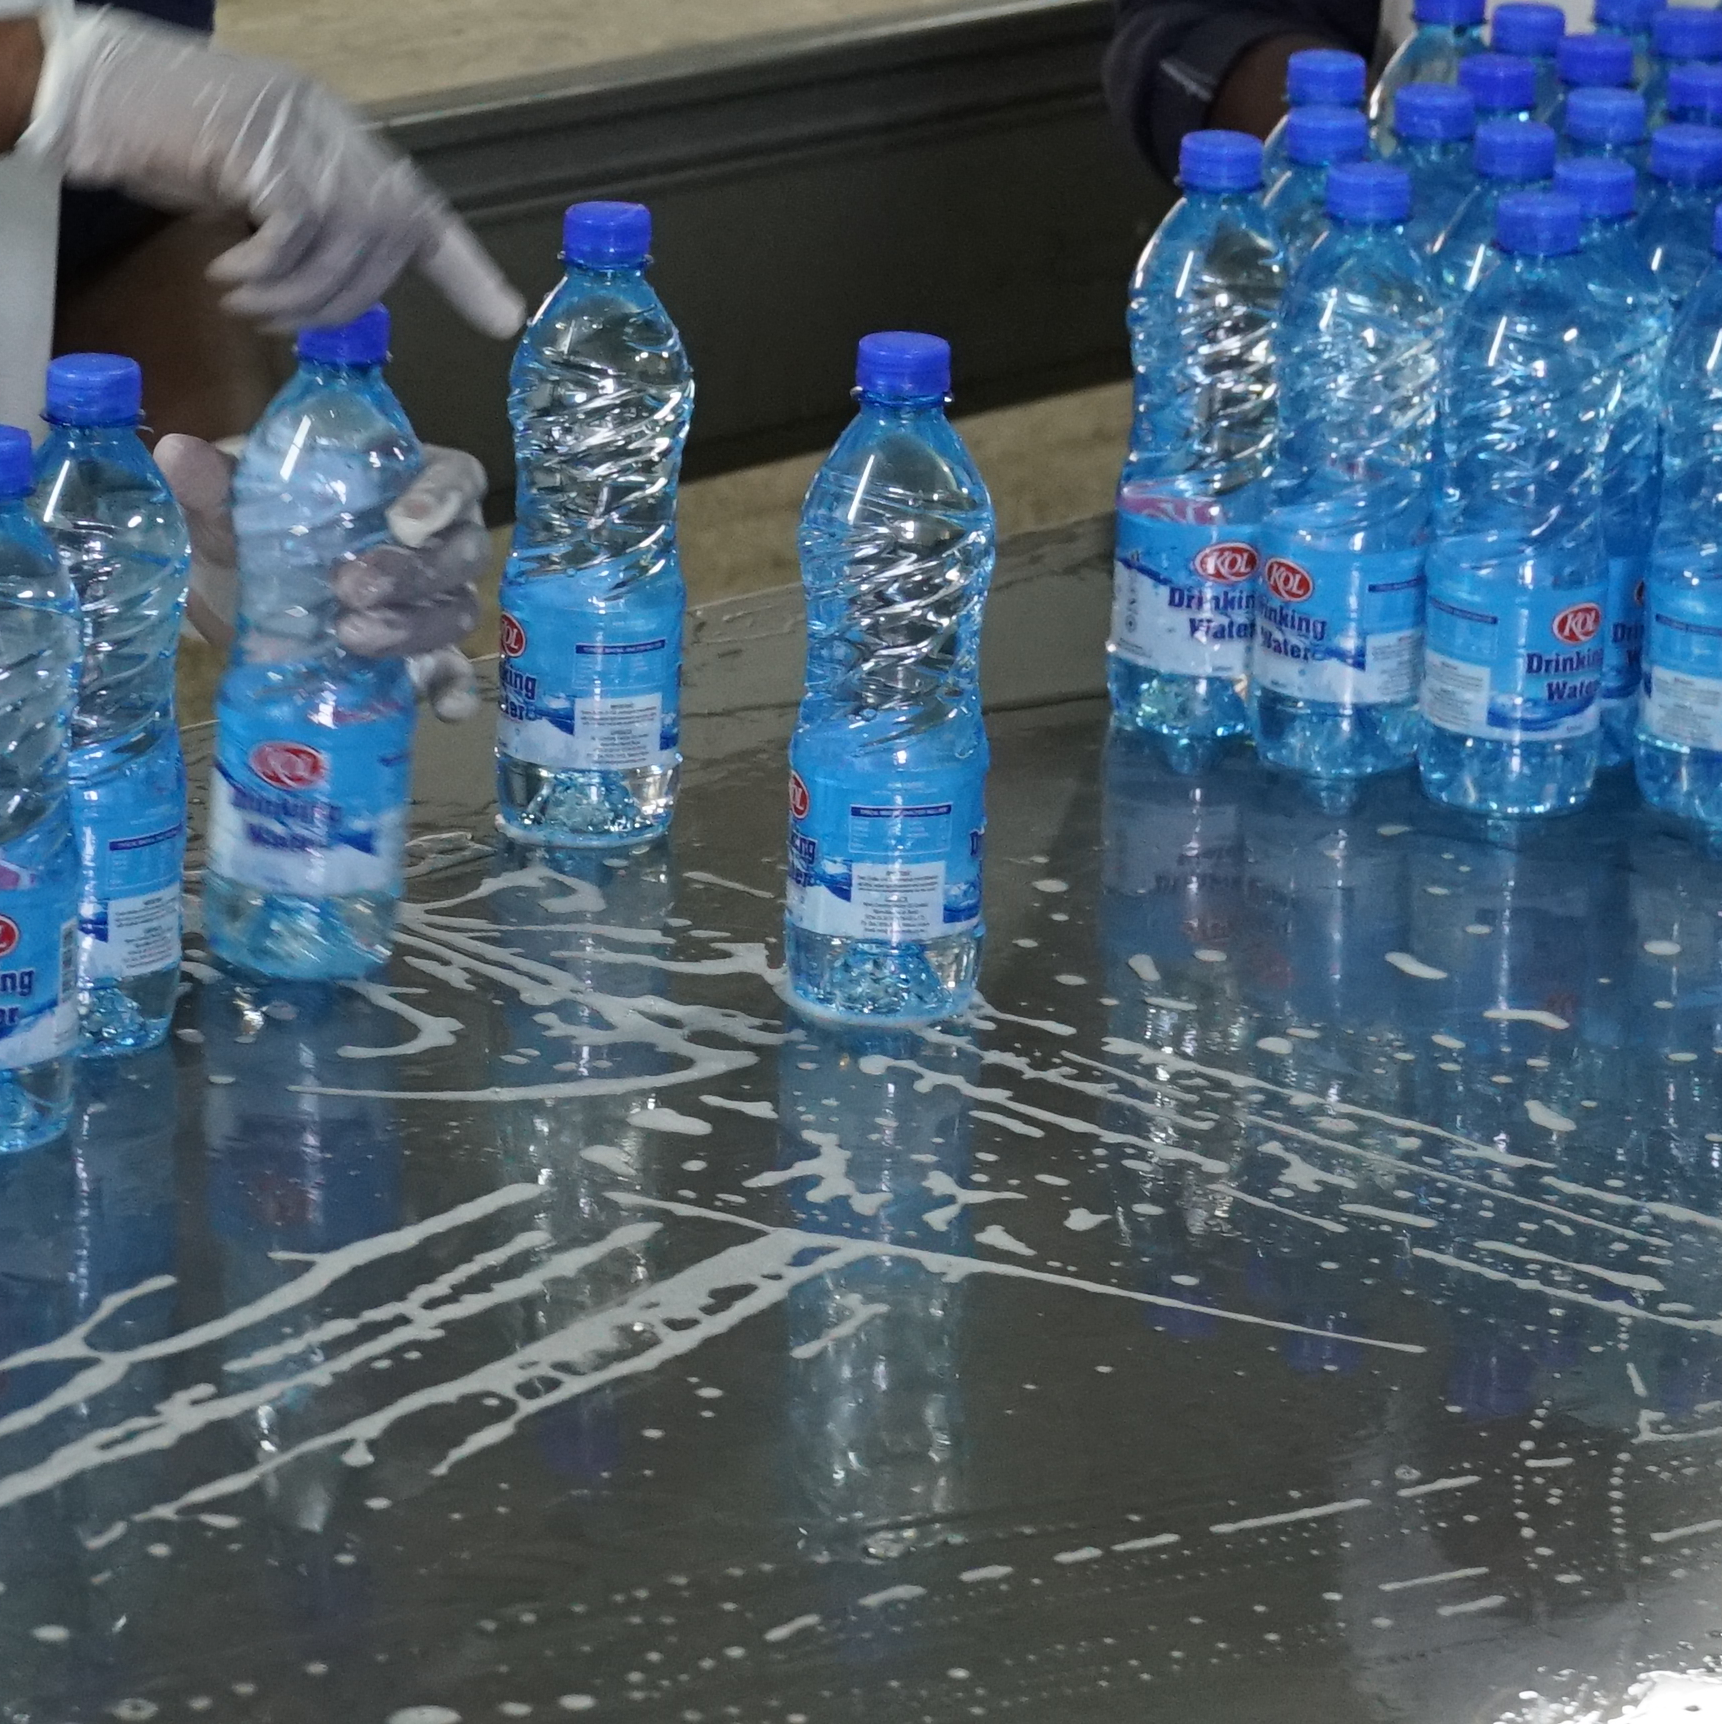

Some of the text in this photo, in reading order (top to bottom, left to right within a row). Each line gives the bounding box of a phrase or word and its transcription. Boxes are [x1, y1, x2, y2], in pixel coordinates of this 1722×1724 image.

[1210, 549, 1253, 580] KOL
[1270, 564, 1305, 599] KOL
[1169, 586, 1255, 611] Drinkin
[1563, 609, 1597, 641] KOL
